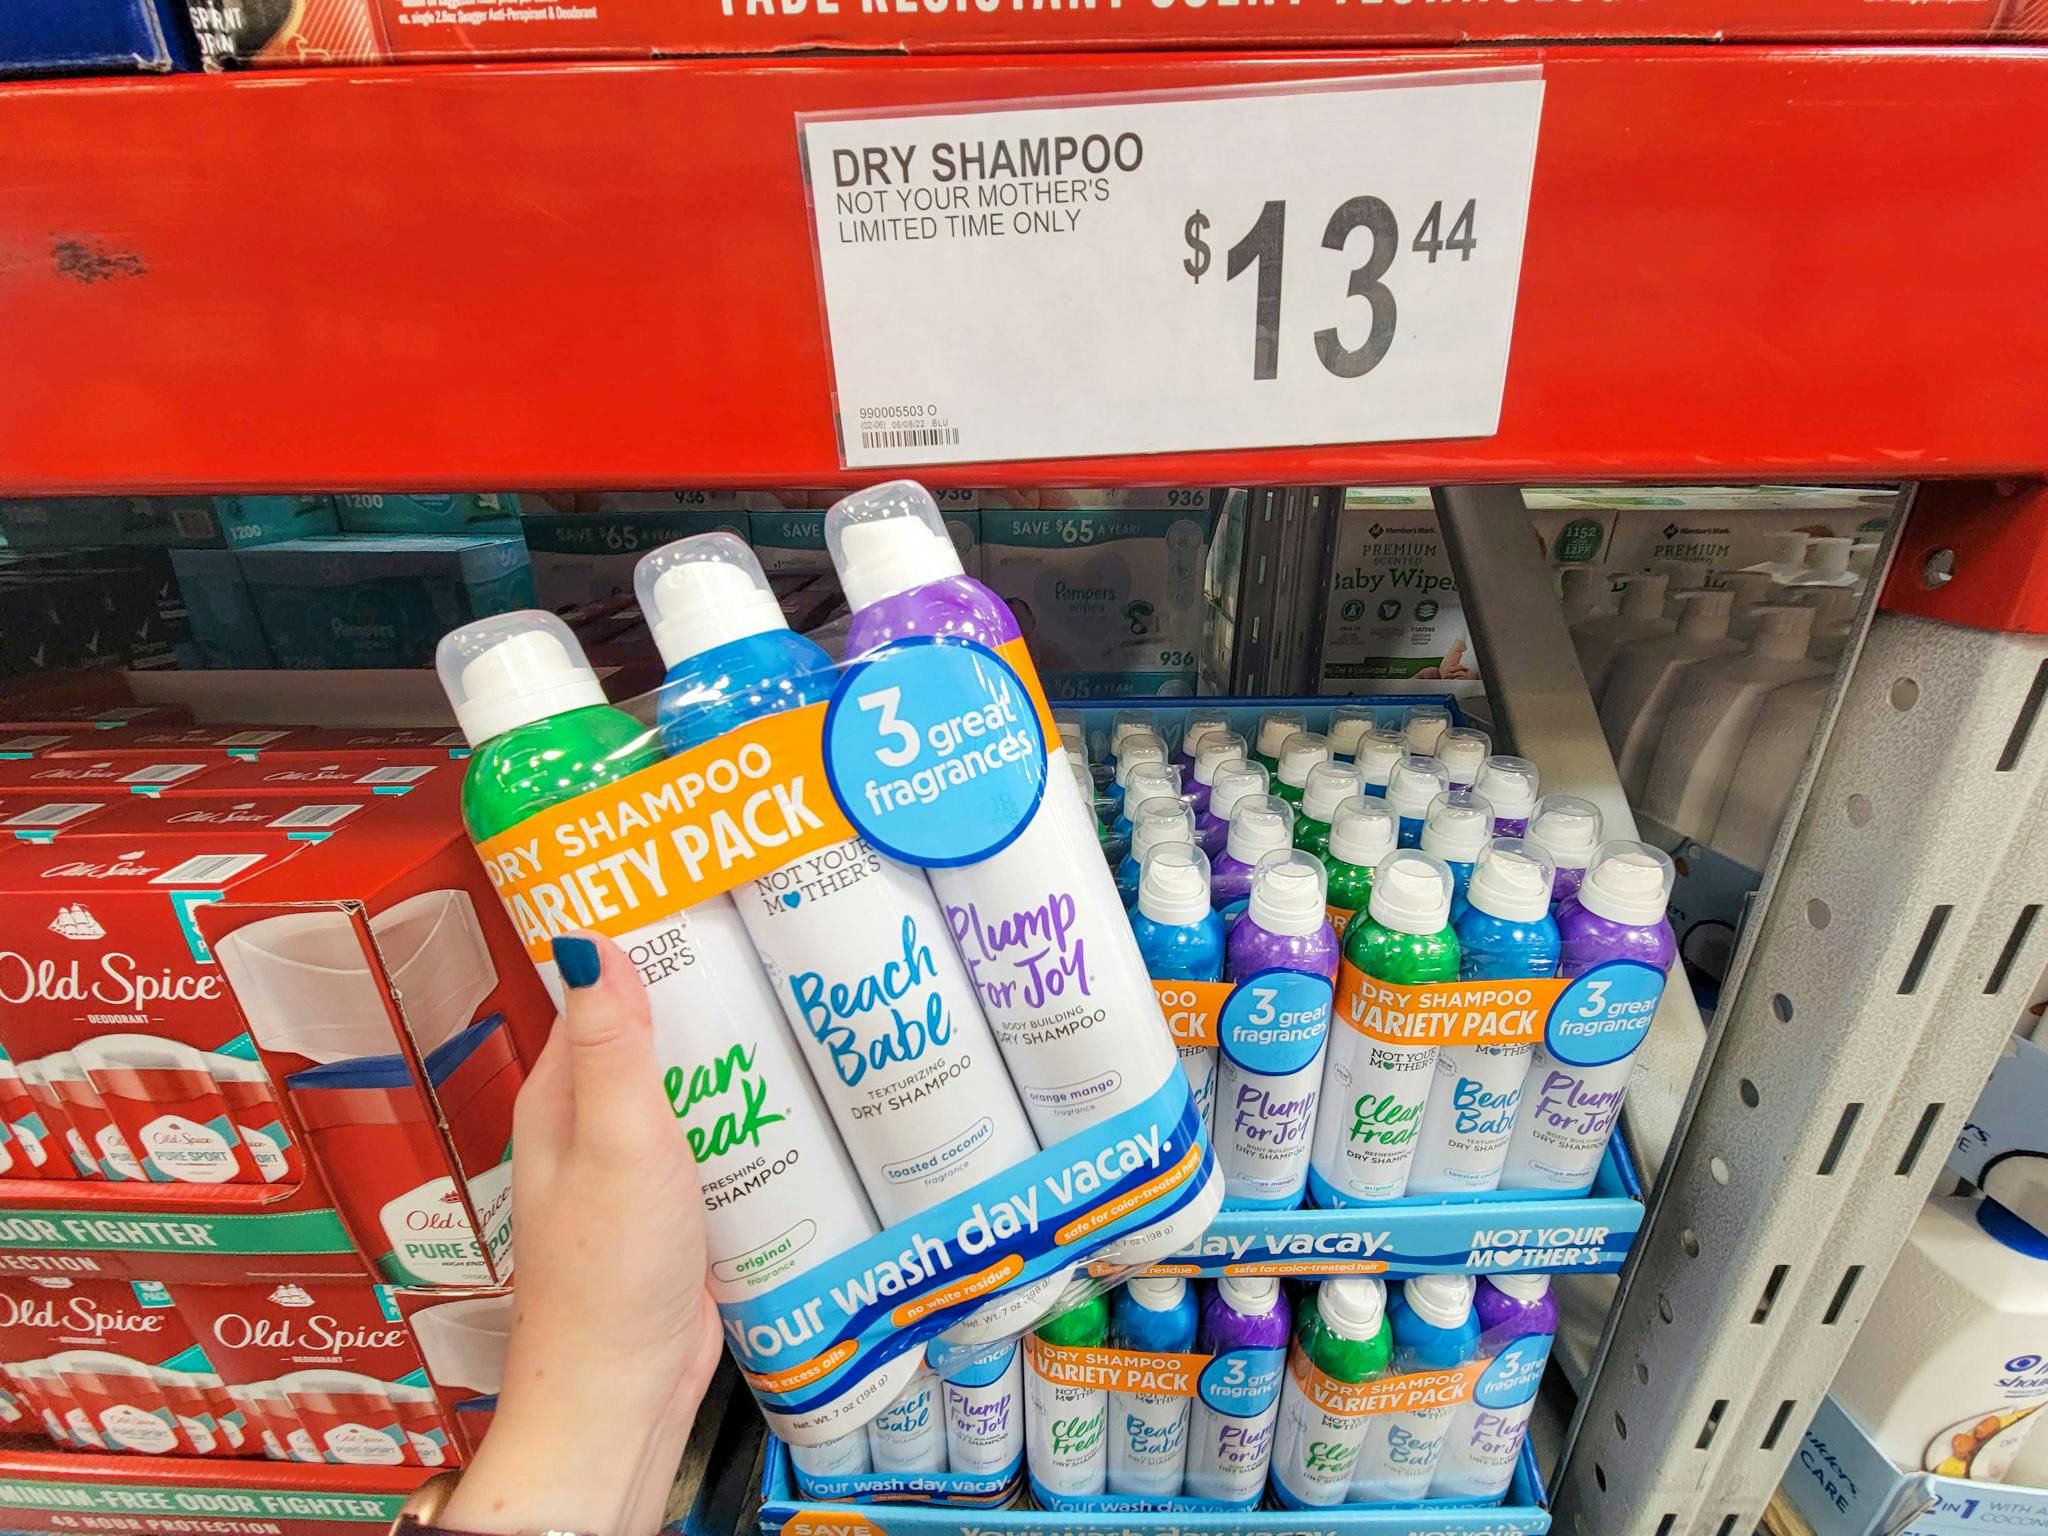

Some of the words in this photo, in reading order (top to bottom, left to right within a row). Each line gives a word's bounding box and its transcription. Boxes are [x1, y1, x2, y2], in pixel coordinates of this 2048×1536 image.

[832, 145, 916, 187] DRY
[932, 132, 1143, 182] SHAMPOO
[837, 190, 888, 215] NOT
[896, 186, 970, 212] YOUR
[978, 178, 1110, 208] MOTHER'S
[840, 217, 937, 243] LIMITED
[945, 213, 1005, 238] TIME
[1013, 209, 1082, 234] ONLY
[860, 405, 923, 418] 990005503
[1167, 490, 1204, 506] 936
[782, 523, 820, 537] SAVE
[1012, 521, 1050, 535] SAVE
[1056, 519, 1094, 543] $65
[1362, 543, 1438, 556] PREMIUM
[1655, 544, 1730, 557] PREMIUM
[1055, 581, 1116, 601] Pampers
[1160, 652, 1194, 666] 936
[857, 685, 921, 767] 3
[928, 694, 1017, 757] great
[864, 729, 1033, 816] fragrances
[485, 838, 543, 888] DRY
[554, 742, 772, 858] SHAMPOO
[671, 775, 825, 883] PACK
[754, 865, 804, 897] NOT
[804, 838, 876, 878] YOUR
[945, 893, 1076, 961] Plump
[628, 926, 688, 966] OUR
[0, 951, 89, 1004] Old
[92, 952, 222, 1011] Spice
[788, 914, 939, 1044] Beach
[967, 957, 1017, 1010] For
[1013, 938, 1091, 1009] Joy
[1249, 987, 1278, 1025] 3
[1279, 1002, 1327, 1028] great
[1361, 980, 1413, 1008] DRY
[1418, 988, 1533, 1010] SHAMPOO
[1578, 980, 1613, 1018] 3
[88, 1014, 149, 1024] DEODORANT
[1022, 1009, 1107, 1045] SHAMPOO
[1029, 1005, 1084, 1029] BUILDING
[1351, 993, 1456, 1038] VARIETY
[1461, 1010, 1540, 1038] PACK
[827, 991, 951, 1087] Babe
[1233, 1020, 1328, 1045] fragrances
[1371, 1047, 1404, 1065] NOT
[664, 1042, 757, 1119] ean
[851, 1101, 883, 1120] DRY
[888, 1055, 971, 1111] SHAMPOO
[867, 1057, 946, 1100] TEXTURIZING
[1029, 1091, 1067, 1104] orange
[1070, 1077, 1114, 1100] mango
[1053, 1103, 1096, 1118] fragrance
[1236, 1084, 1316, 1119] Plump
[1534, 1096, 1577, 1129] For
[686, 1075, 787, 1163] eak
[1235, 1111, 1272, 1142] For
[1272, 1114, 1310, 1145] Joy
[888, 1156, 938, 1180] toasted
[940, 1124, 990, 1162] coconut
[1236, 1144, 1257, 1157] DRY
[1448, 1139, 1472, 1150] DRY
[1533, 1131, 1562, 1145] DRY
[155, 1151, 188, 1162] PURE
[190, 1151, 228, 1162] SPORT
[1346, 1149, 1369, 1164] DRY
[701, 1155, 767, 1195] FRESHING
[704, 1148, 799, 1211] SHAMPOO
[924, 1160, 970, 1187] fragrance
[1063, 1224, 1090, 1241] safe
[1090, 1210, 1110, 1226] for
[1110, 1169, 1183, 1216] color-treated
[62, 1219, 217, 1247] FIGHTER
[406, 1210, 455, 1231] Old
[405, 1243, 468, 1259] PURE
[726, 1296, 826, 1359] Your
[829, 1232, 953, 1318] wash
[957, 1185, 1040, 1255] day
[1044, 1123, 1173, 1206] vacay.
[1265, 1231, 1394, 1263] vacay.
[1471, 1228, 1532, 1249] NOT
[1537, 1226, 1610, 1246] YOUR
[735, 1238, 793, 1274] original
[1149, 1266, 1193, 1275] residue
[1260, 1265, 1277, 1273] for
[1277, 1263, 1356, 1273] color-treated
[1358, 1262, 1379, 1271] hair
[747, 1259, 796, 1287] fragrance
[907, 1305, 924, 1318] no
[927, 1290, 962, 1309] white
[964, 1265, 1012, 1295] residue
[0, 1293, 60, 1327] Old
[62, 1296, 163, 1336] Spice
[213, 1313, 295, 1349] Old
[298, 1315, 406, 1354] Spice
[781, 1366, 821, 1387] excess
[822, 1348, 847, 1369] oils
[1036, 1353, 1123, 1387] VARIETY
[1127, 1370, 1190, 1391] PACK
[1043, 1347, 1080, 1363] DRY
[1085, 1353, 1182, 1370] SHAMPOO
[1223, 1358, 1249, 1385] 3
[1498, 1351, 1524, 1379] 3
[1313, 1385, 1402, 1412] VARIETY
[1407, 1383, 1466, 1406] PACK
[1324, 1379, 1368, 1396] DRY
[1371, 1372, 1464, 1394] SHAMPOO
[1217, 1441, 1250, 1463] For
[1470, 1433, 1506, 1454] For
[805, 1478, 850, 1494] Your
[853, 1477, 904, 1493] wash
[908, 1476, 947, 1494] day
[1800, 1449, 1850, 1515] CARE
[174, 1494, 263, 1513] ODOR
[261, 1496, 385, 1518] FIGHTER
[1100, 1499, 1152, 1513] wash
[1989, 1501, 2032, 1514] WITH
[51, 1515, 80, 1527] 48
[84, 1516, 142, 1531] HOUR
[150, 1519, 282, 1535] PROTECTION
